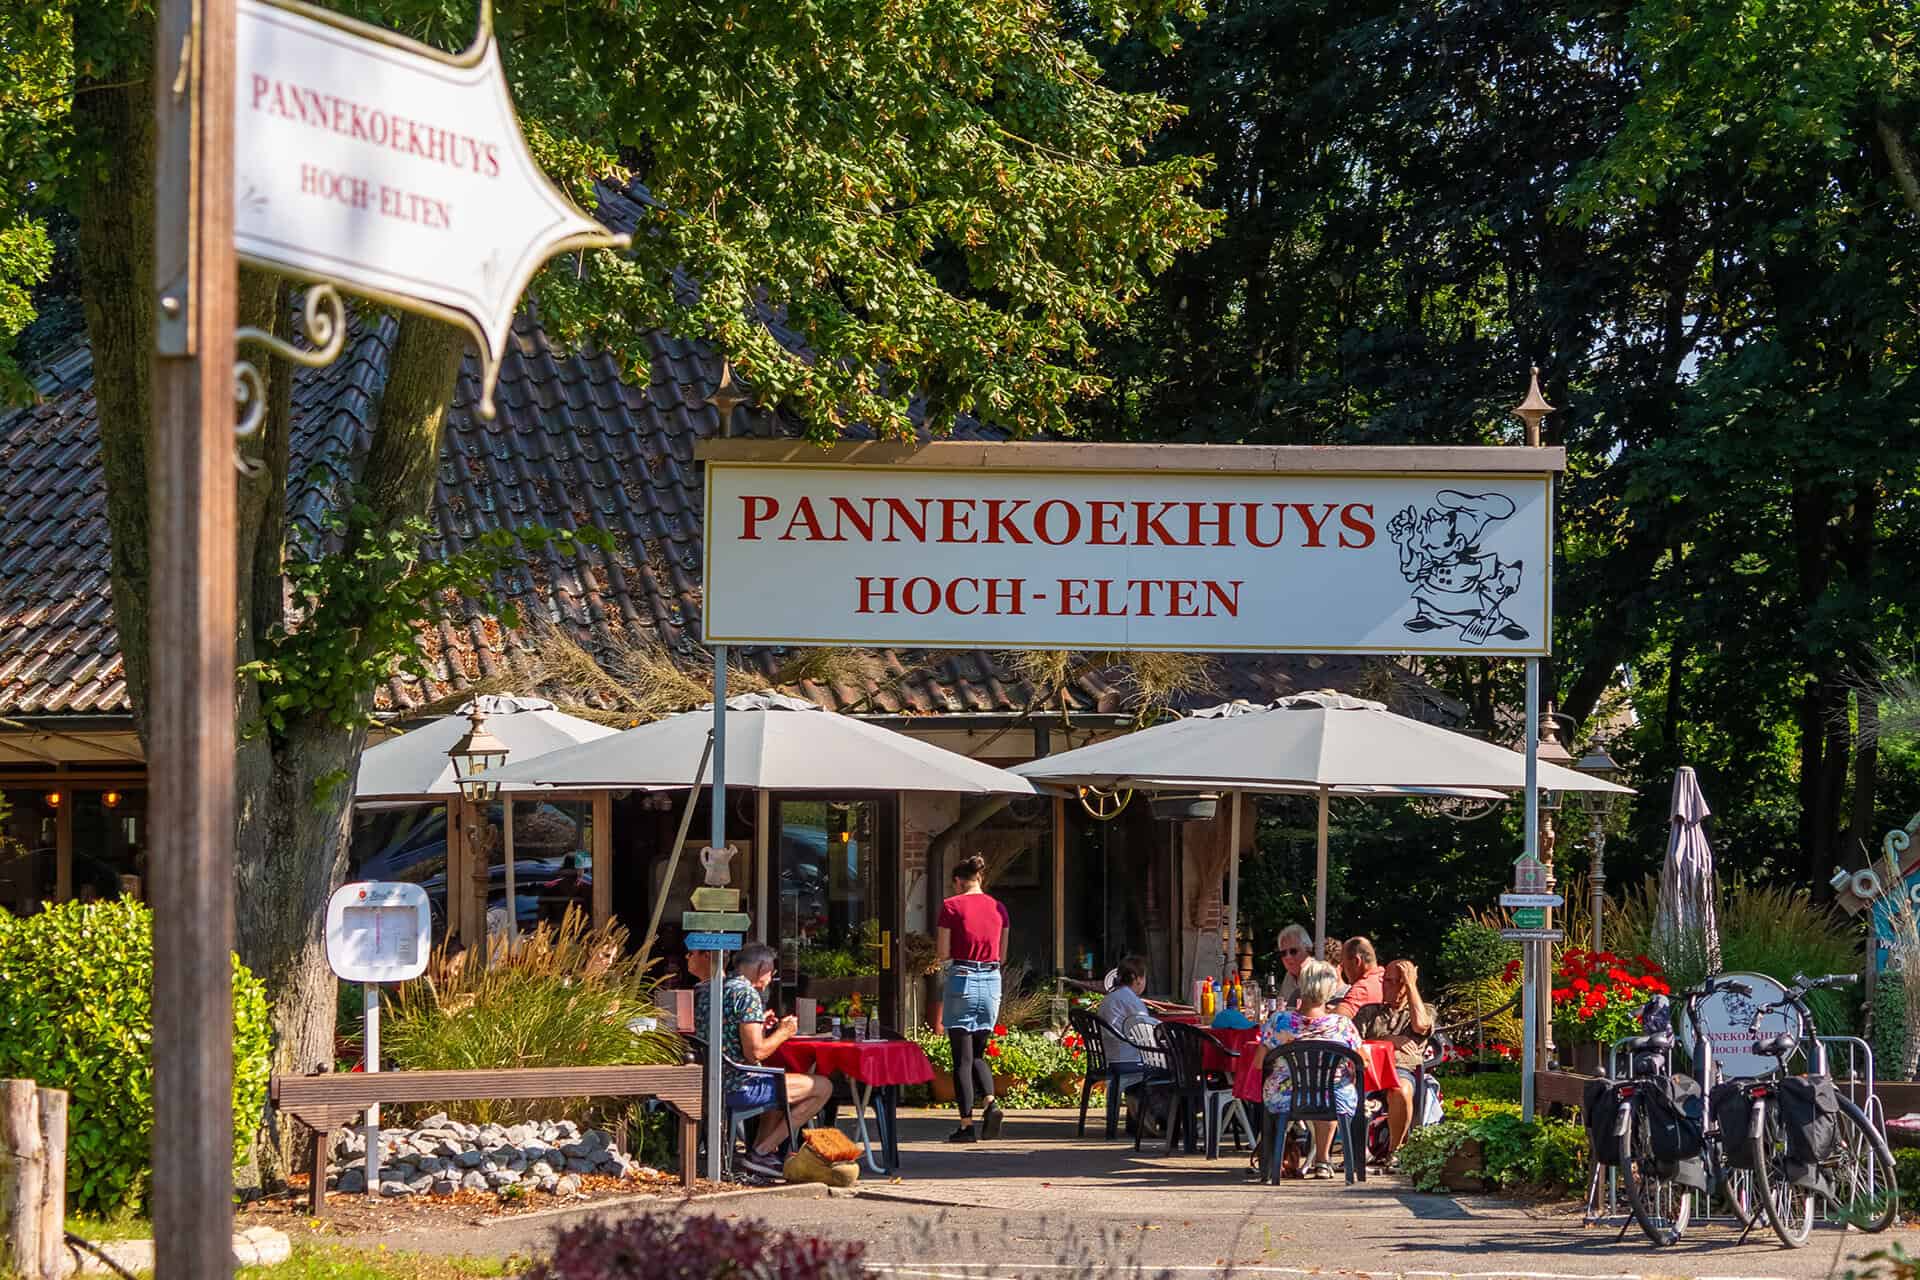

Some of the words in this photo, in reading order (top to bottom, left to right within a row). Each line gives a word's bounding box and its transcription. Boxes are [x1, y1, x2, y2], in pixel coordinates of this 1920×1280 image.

[251, 72, 500, 178] PANNEKOEKHUYS
[301, 163, 454, 229] HOCH-ELTEN
[737, 495, 1376, 549] PANNEKOEKHUYS
[855, 576, 1244, 617] HOCH-ELTEN
